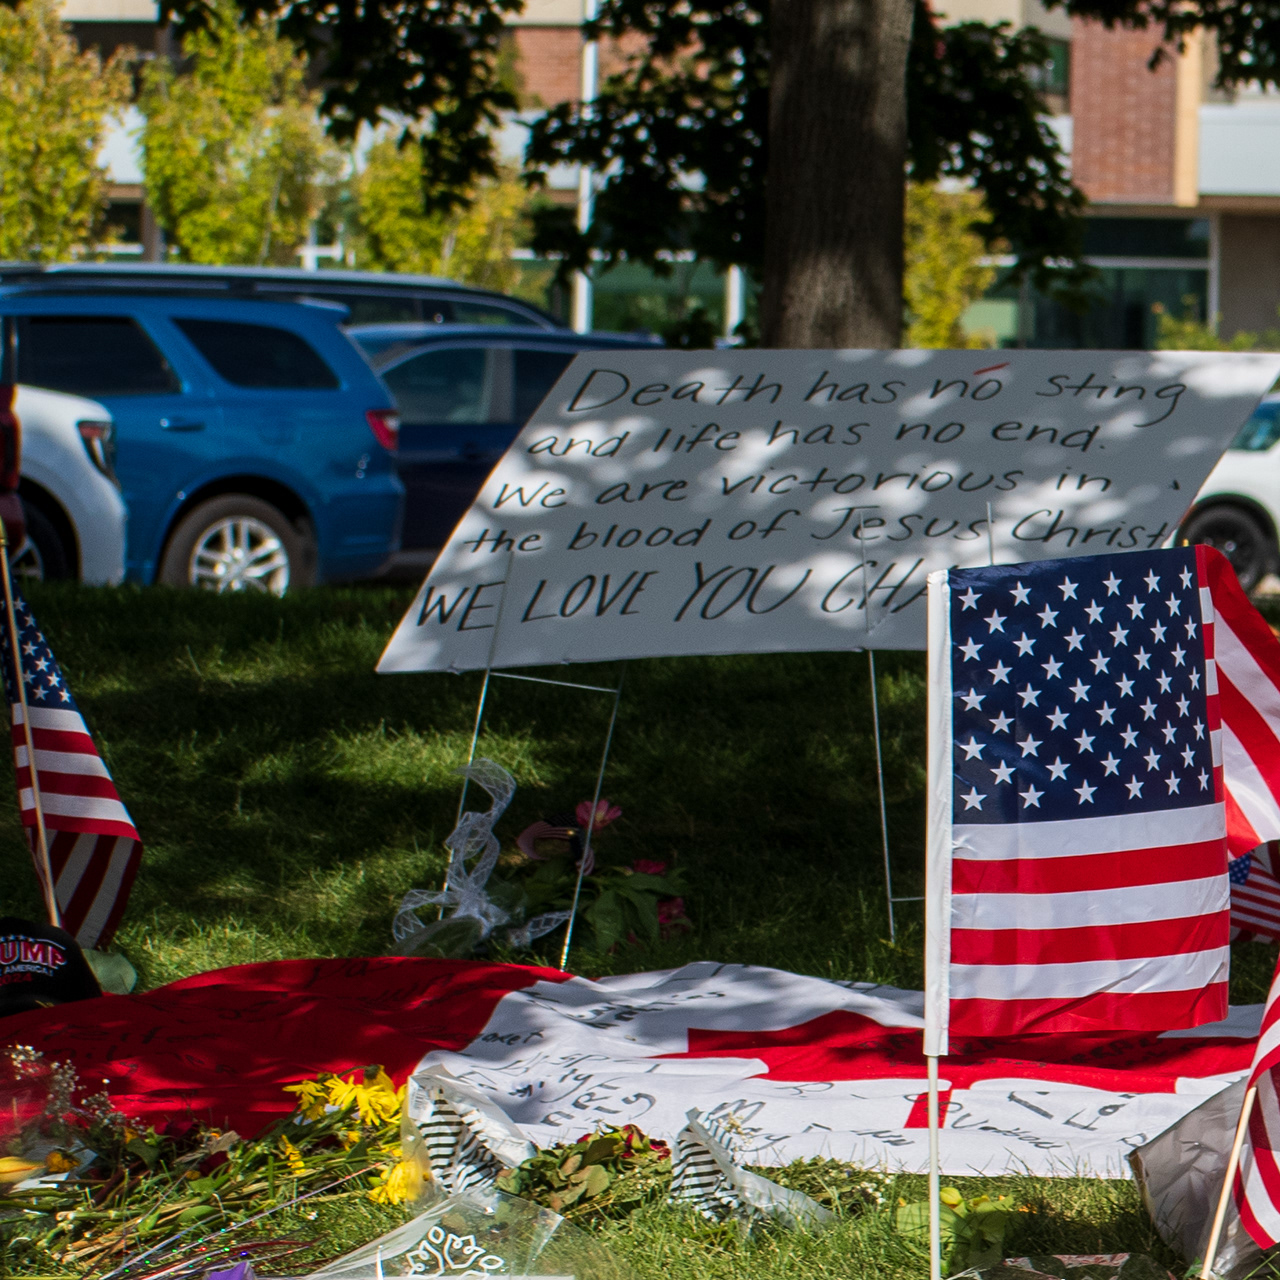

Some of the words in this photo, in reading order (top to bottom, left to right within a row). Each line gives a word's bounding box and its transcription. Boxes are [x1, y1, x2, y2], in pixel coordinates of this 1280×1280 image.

[565, 368, 784, 415] Death
[802, 375, 906, 404] has
[930, 376, 1003, 404] no
[1036, 371, 1188, 428] sting
[526, 430, 631, 460] and
[652, 425, 741, 456] life
[765, 418, 863, 449] has
[894, 419, 964, 447] no
[990, 416, 1109, 453] end.
[491, 480, 589, 509] We
[594, 475, 689, 503] are
[720, 465, 1022, 497] victorious
[1056, 468, 1113, 493] in
[462, 528, 543, 553] the
[564, 517, 713, 553] blood
[727, 508, 799, 541] of
[811, 506, 994, 543] Jesus
[1010, 506, 1169, 549] Christ
[416, 583, 504, 632] WE
[519, 568, 660, 623] LOVE
[673, 562, 812, 621] YOU
[820, 556, 942, 615] CHA
[0, 941, 67, 970] UMP
[0, 973, 32, 986] 024
